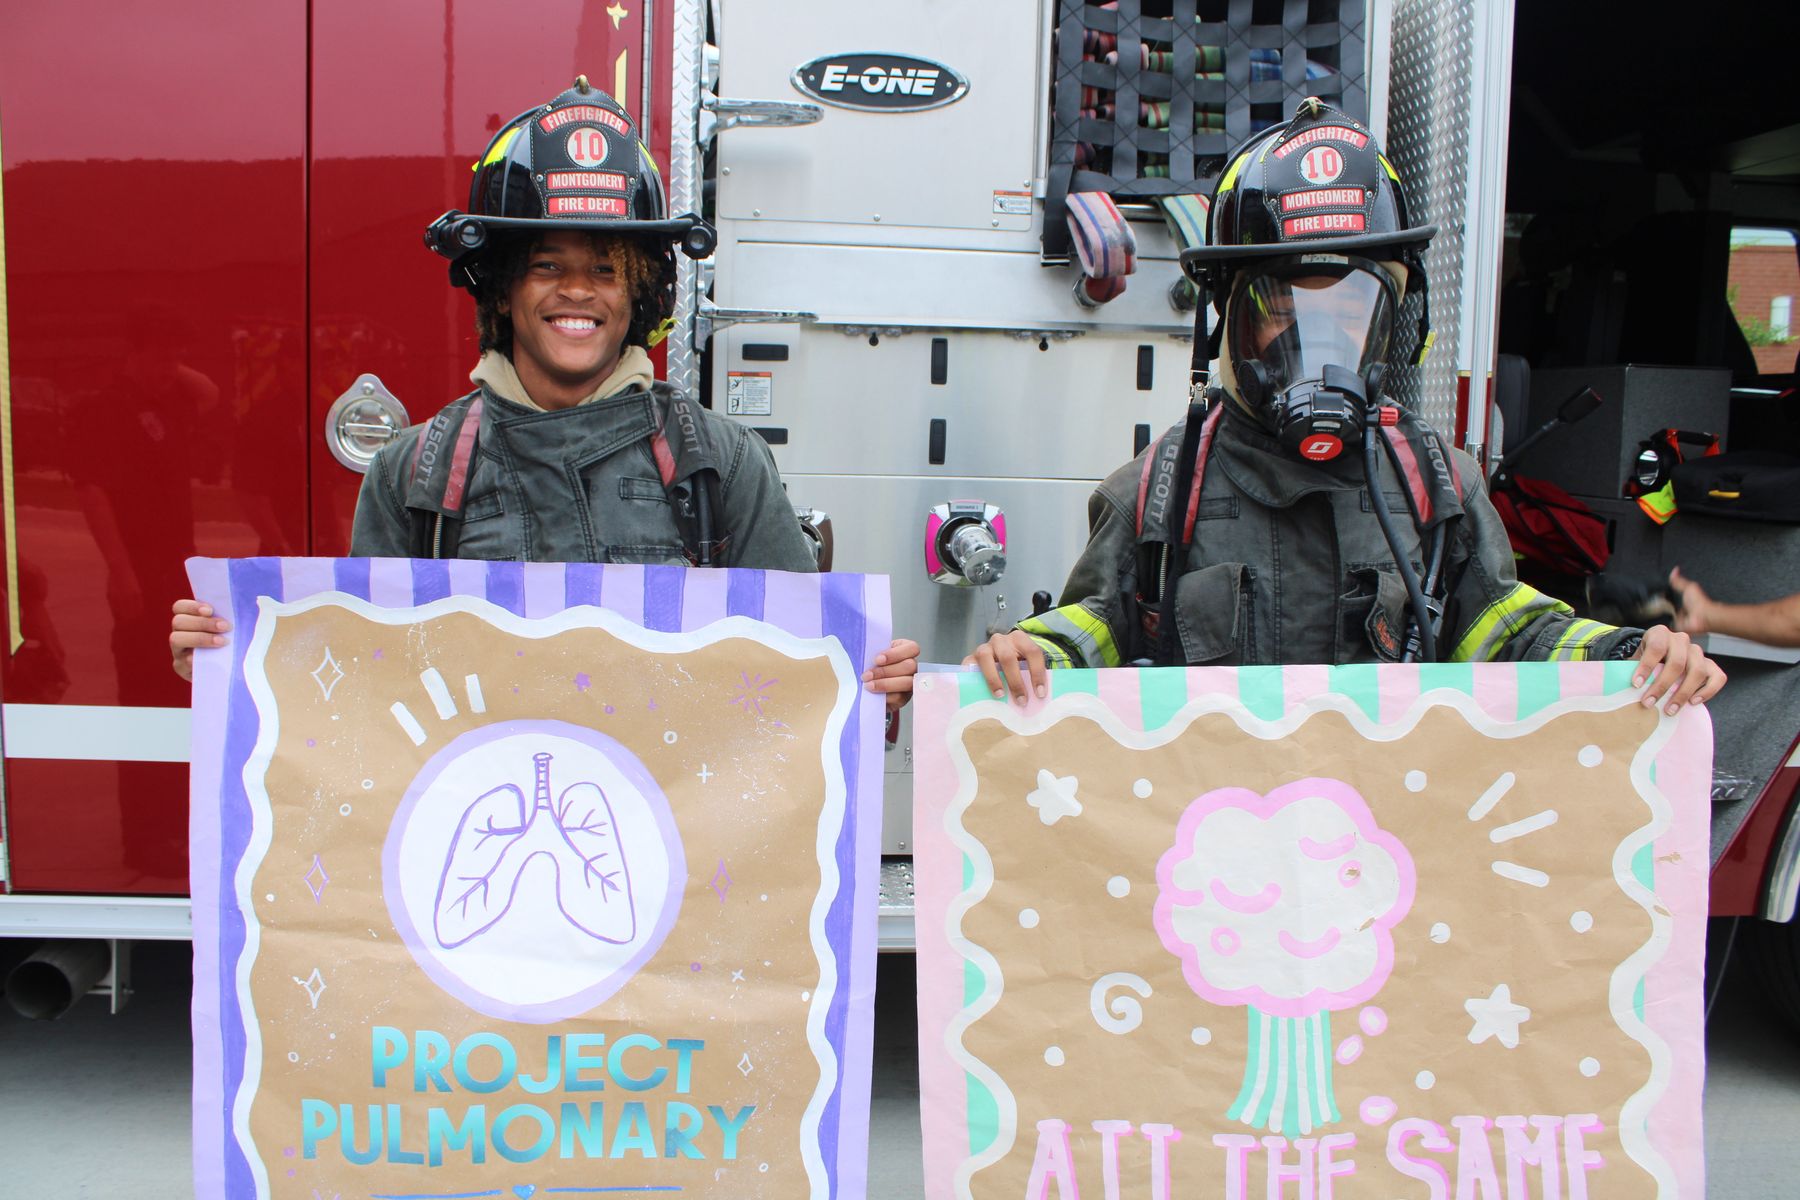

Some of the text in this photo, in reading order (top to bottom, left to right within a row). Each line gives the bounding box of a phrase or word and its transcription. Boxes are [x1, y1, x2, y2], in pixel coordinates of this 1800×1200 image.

[820, 65, 940, 96] E-ONE
[546, 107, 623, 131] FIREFIGHTER
[574, 132, 604, 161] 10
[1280, 127, 1360, 156] FIREFIGHTER
[1306, 149, 1338, 179] 10
[552, 172, 624, 188] MONTGOMERY
[558, 198, 619, 212] FIRE DEPT.
[1286, 190, 1360, 209] MONTGOMERY
[1293, 214, 1357, 232] FIRE DEPT.
[674, 402, 702, 455] SCOTT
[417, 428, 445, 489] SCOTT
[1422, 434, 1457, 496] SCOTT
[1151, 460, 1175, 524] SCOTT
[372, 1025, 705, 1094] PROJECT
[301, 1097, 758, 1168] PULMONARY
